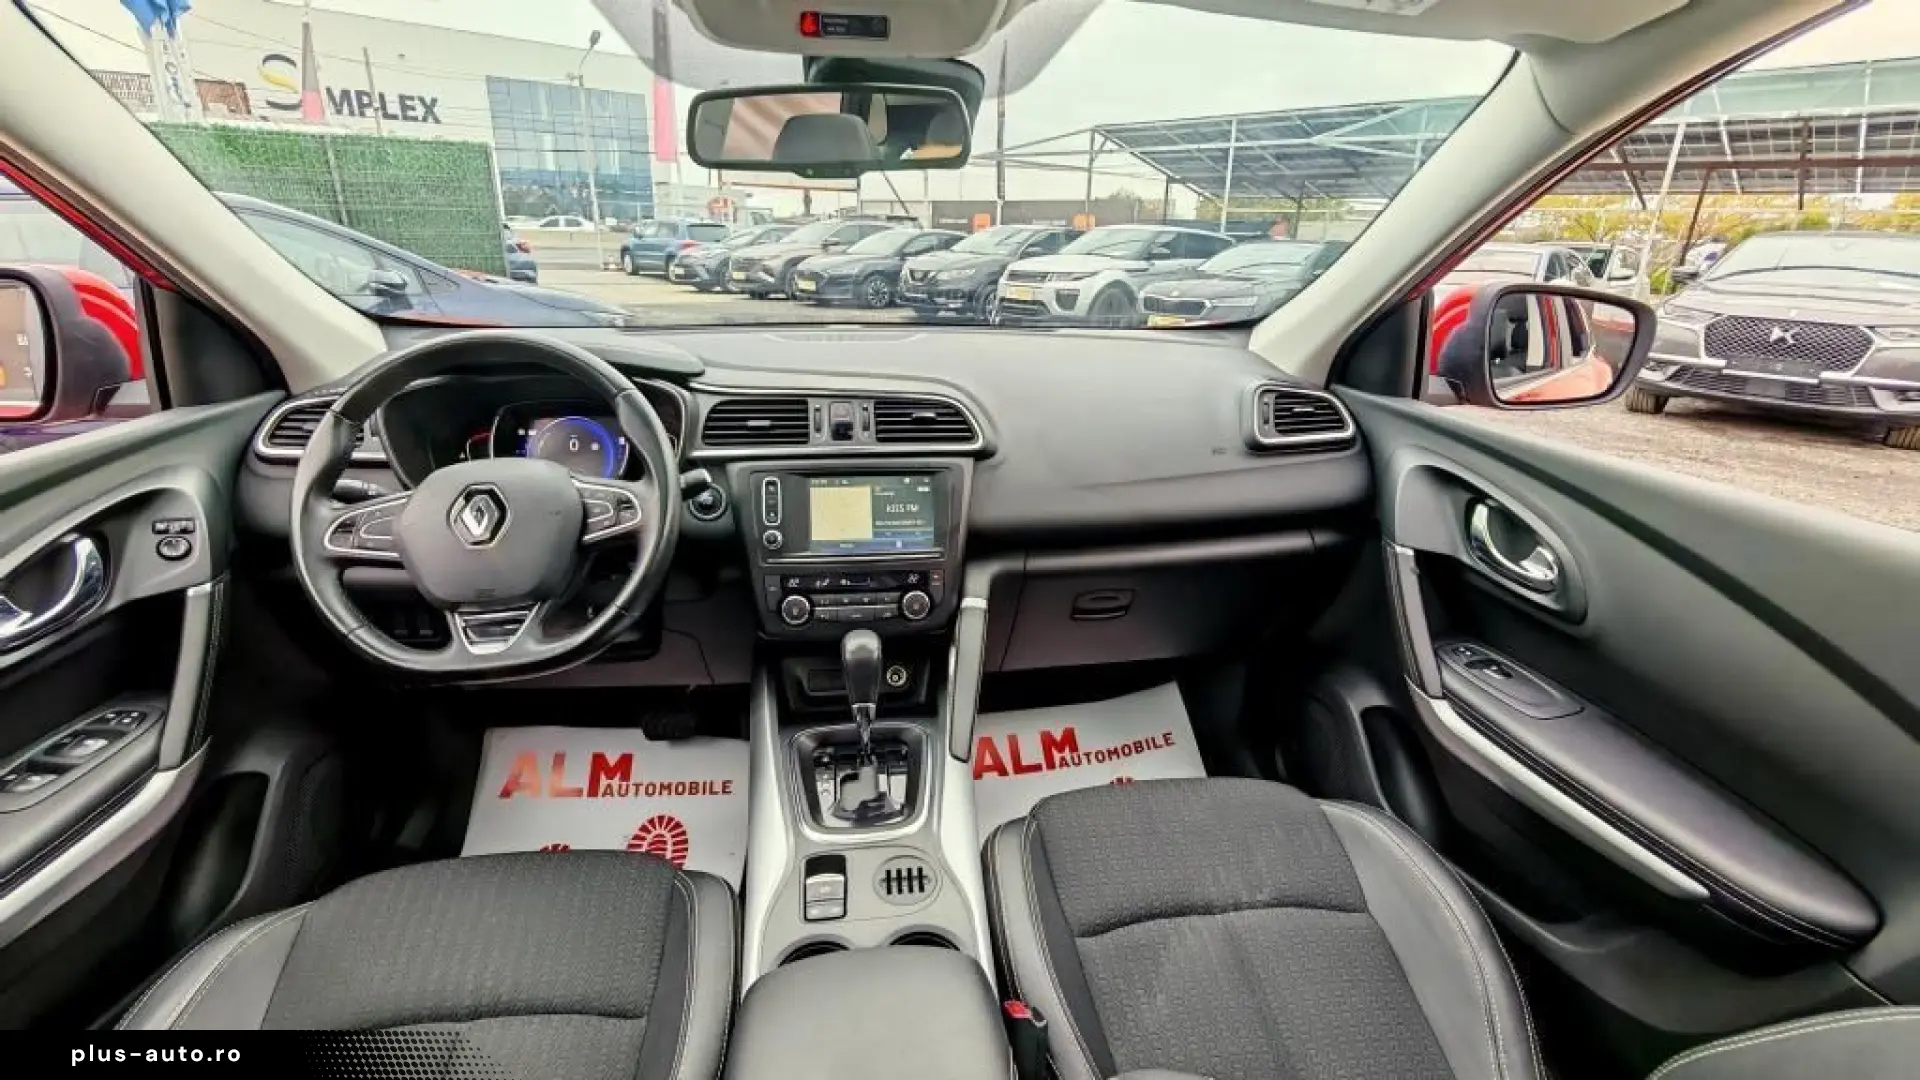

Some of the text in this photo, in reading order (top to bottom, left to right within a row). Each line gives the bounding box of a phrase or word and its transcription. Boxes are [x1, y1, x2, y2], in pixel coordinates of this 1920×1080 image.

[258, 53, 442, 124] SMPLEX
[499, 751, 734, 798] ALM AUTOMOBILE
[973, 727, 1176, 780] ALM AUTOMOBILE
